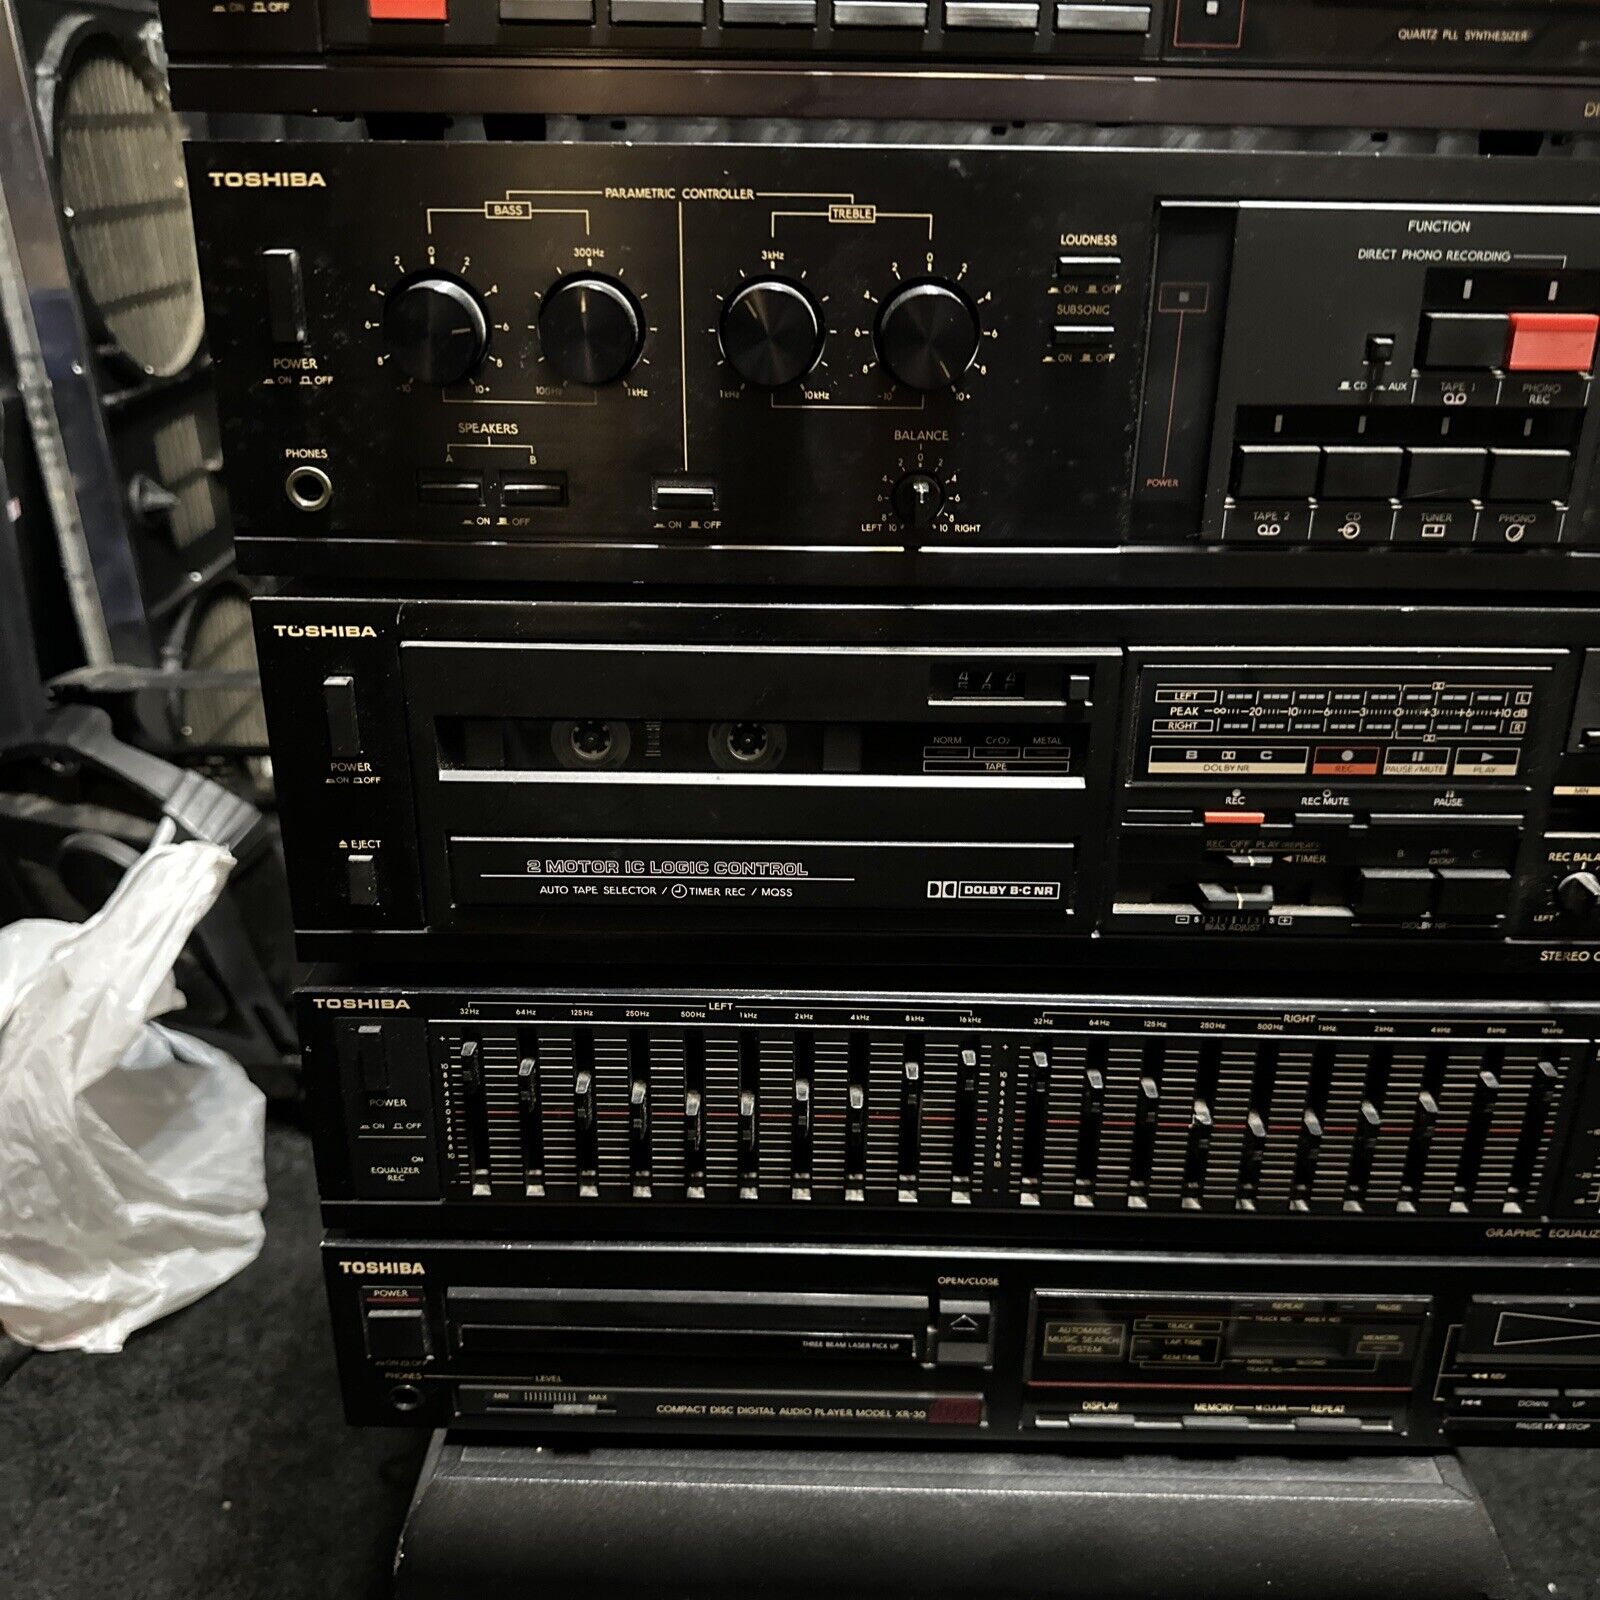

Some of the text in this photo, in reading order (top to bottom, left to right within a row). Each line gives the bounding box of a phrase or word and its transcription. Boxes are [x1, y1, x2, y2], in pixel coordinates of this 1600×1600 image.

[267, 2, 290, 12] OFF
[1398, 28, 1529, 42] QUARTZ PLL SYNTHESIZER
[208, 171, 327, 188] TOSHIBA
[604, 188, 755, 200] PARAMETRIC CONTROLLER
[494, 205, 523, 217] BASS
[832, 209, 872, 219] TREBLE
[1407, 219, 1472, 234] FUNCTION
[1060, 233, 1118, 246] LOUDNESS
[1357, 248, 1512, 263] DIRECT PHONO RECORDING
[1063, 284, 1122, 294] ON OFF
[1056, 304, 1110, 316] SUBSONIC
[1057, 353, 1116, 363] ON OFF
[273, 358, 318, 370] POWER
[277, 375, 334, 385] ON OFF
[1353, 381, 1408, 391] CD AUX
[1440, 382, 1466, 392] TAPE
[1522, 383, 1562, 393] PHONO
[1528, 394, 1551, 405] REC
[457, 422, 519, 435] SPEAKERS
[893, 430, 950, 442] BALANCE
[285, 448, 328, 459] PHONES
[445, 454, 454, 463] A
[1146, 478, 1180, 488] POWER
[1252, 511, 1279, 521] TAPE
[1345, 512, 1361, 522] CD
[1420, 512, 1452, 523] TUNER
[1498, 513, 1537, 523] PHONO
[476, 517, 531, 527] ON OFF
[667, 520, 722, 530] ON OFF
[861, 523, 898, 533] LEFT 10
[939, 524, 982, 533] 10 RIGHT
[272, 624, 378, 638] TOSHIBA
[1173, 692, 1527, 702] LEFT L
[1169, 706, 1200, 717] PEAK
[1513, 708, 1528, 718] dB
[1167, 721, 1522, 733] RIGHT R
[933, 736, 962, 744] NORM
[1032, 736, 1063, 745] METAL
[1185, 750, 1198, 760] B
[1260, 750, 1273, 760] C
[330, 762, 373, 772] POWER
[984, 762, 1008, 771] TAPE
[1203, 764, 1250, 773] DOLBY NR
[1334, 765, 1354, 774] REC
[1472, 766, 1497, 774] PLAY
[336, 776, 381, 785] ON OFF
[1225, 796, 1246, 806] REC
[1300, 796, 1350, 806] REC MUTE
[1433, 797, 1464, 807] PAUSE
[350, 839, 382, 849] EJECT
[1205, 840, 1280, 849] REC OFF PLAY
[1294, 854, 1327, 864] TIMER
[1548, 851, 1571, 862] REC
[526, 859, 809, 877] 2 MOTOR IC LOGIC CONTROL
[539, 885, 569, 895] AUTO
[572, 885, 599, 895] TAPE
[603, 885, 657, 896] SELECTOR
[688, 886, 721, 897] TIMER
[725, 886, 746, 897] REC
[964, 885, 1054, 896] DOLBY NR
[1533, 914, 1554, 922] LEFT
[1204, 923, 1261, 933] BIAS ADJUST
[1539, 951, 1590, 962] STEREO
[312, 998, 411, 1010] TOSHIBA
[708, 1001, 735, 1011] LEFT
[1283, 1013, 1316, 1024] RIGHT
[369, 1098, 408, 1108] POWER
[372, 1122, 422, 1130] ON OFF
[411, 1155, 424, 1163] ON
[370, 1166, 420, 1175] EQUALIZER
[387, 1174, 406, 1182] REC
[1485, 1228, 1543, 1238] GRAPHIC
[338, 1260, 426, 1275] TOSHIBA
[937, 1276, 1001, 1286] OPEN/CLOSE
[373, 1289, 409, 1297] POWER
[802, 1340, 900, 1350] THREE BEAM LASER PICK UP
[535, 1374, 563, 1383] LEVEL
[588, 1393, 608, 1401] MAX
[1081, 1401, 1346, 1414] DISPLAY MEMORY REPEAT
[1572, 1400, 1586, 1408] UP
[655, 1404, 927, 1419] COMPACT DISC DIGITAL AUDIO PLAYER MODEL XR-30
[1515, 1422, 1591, 1431] PAUSE STOP
